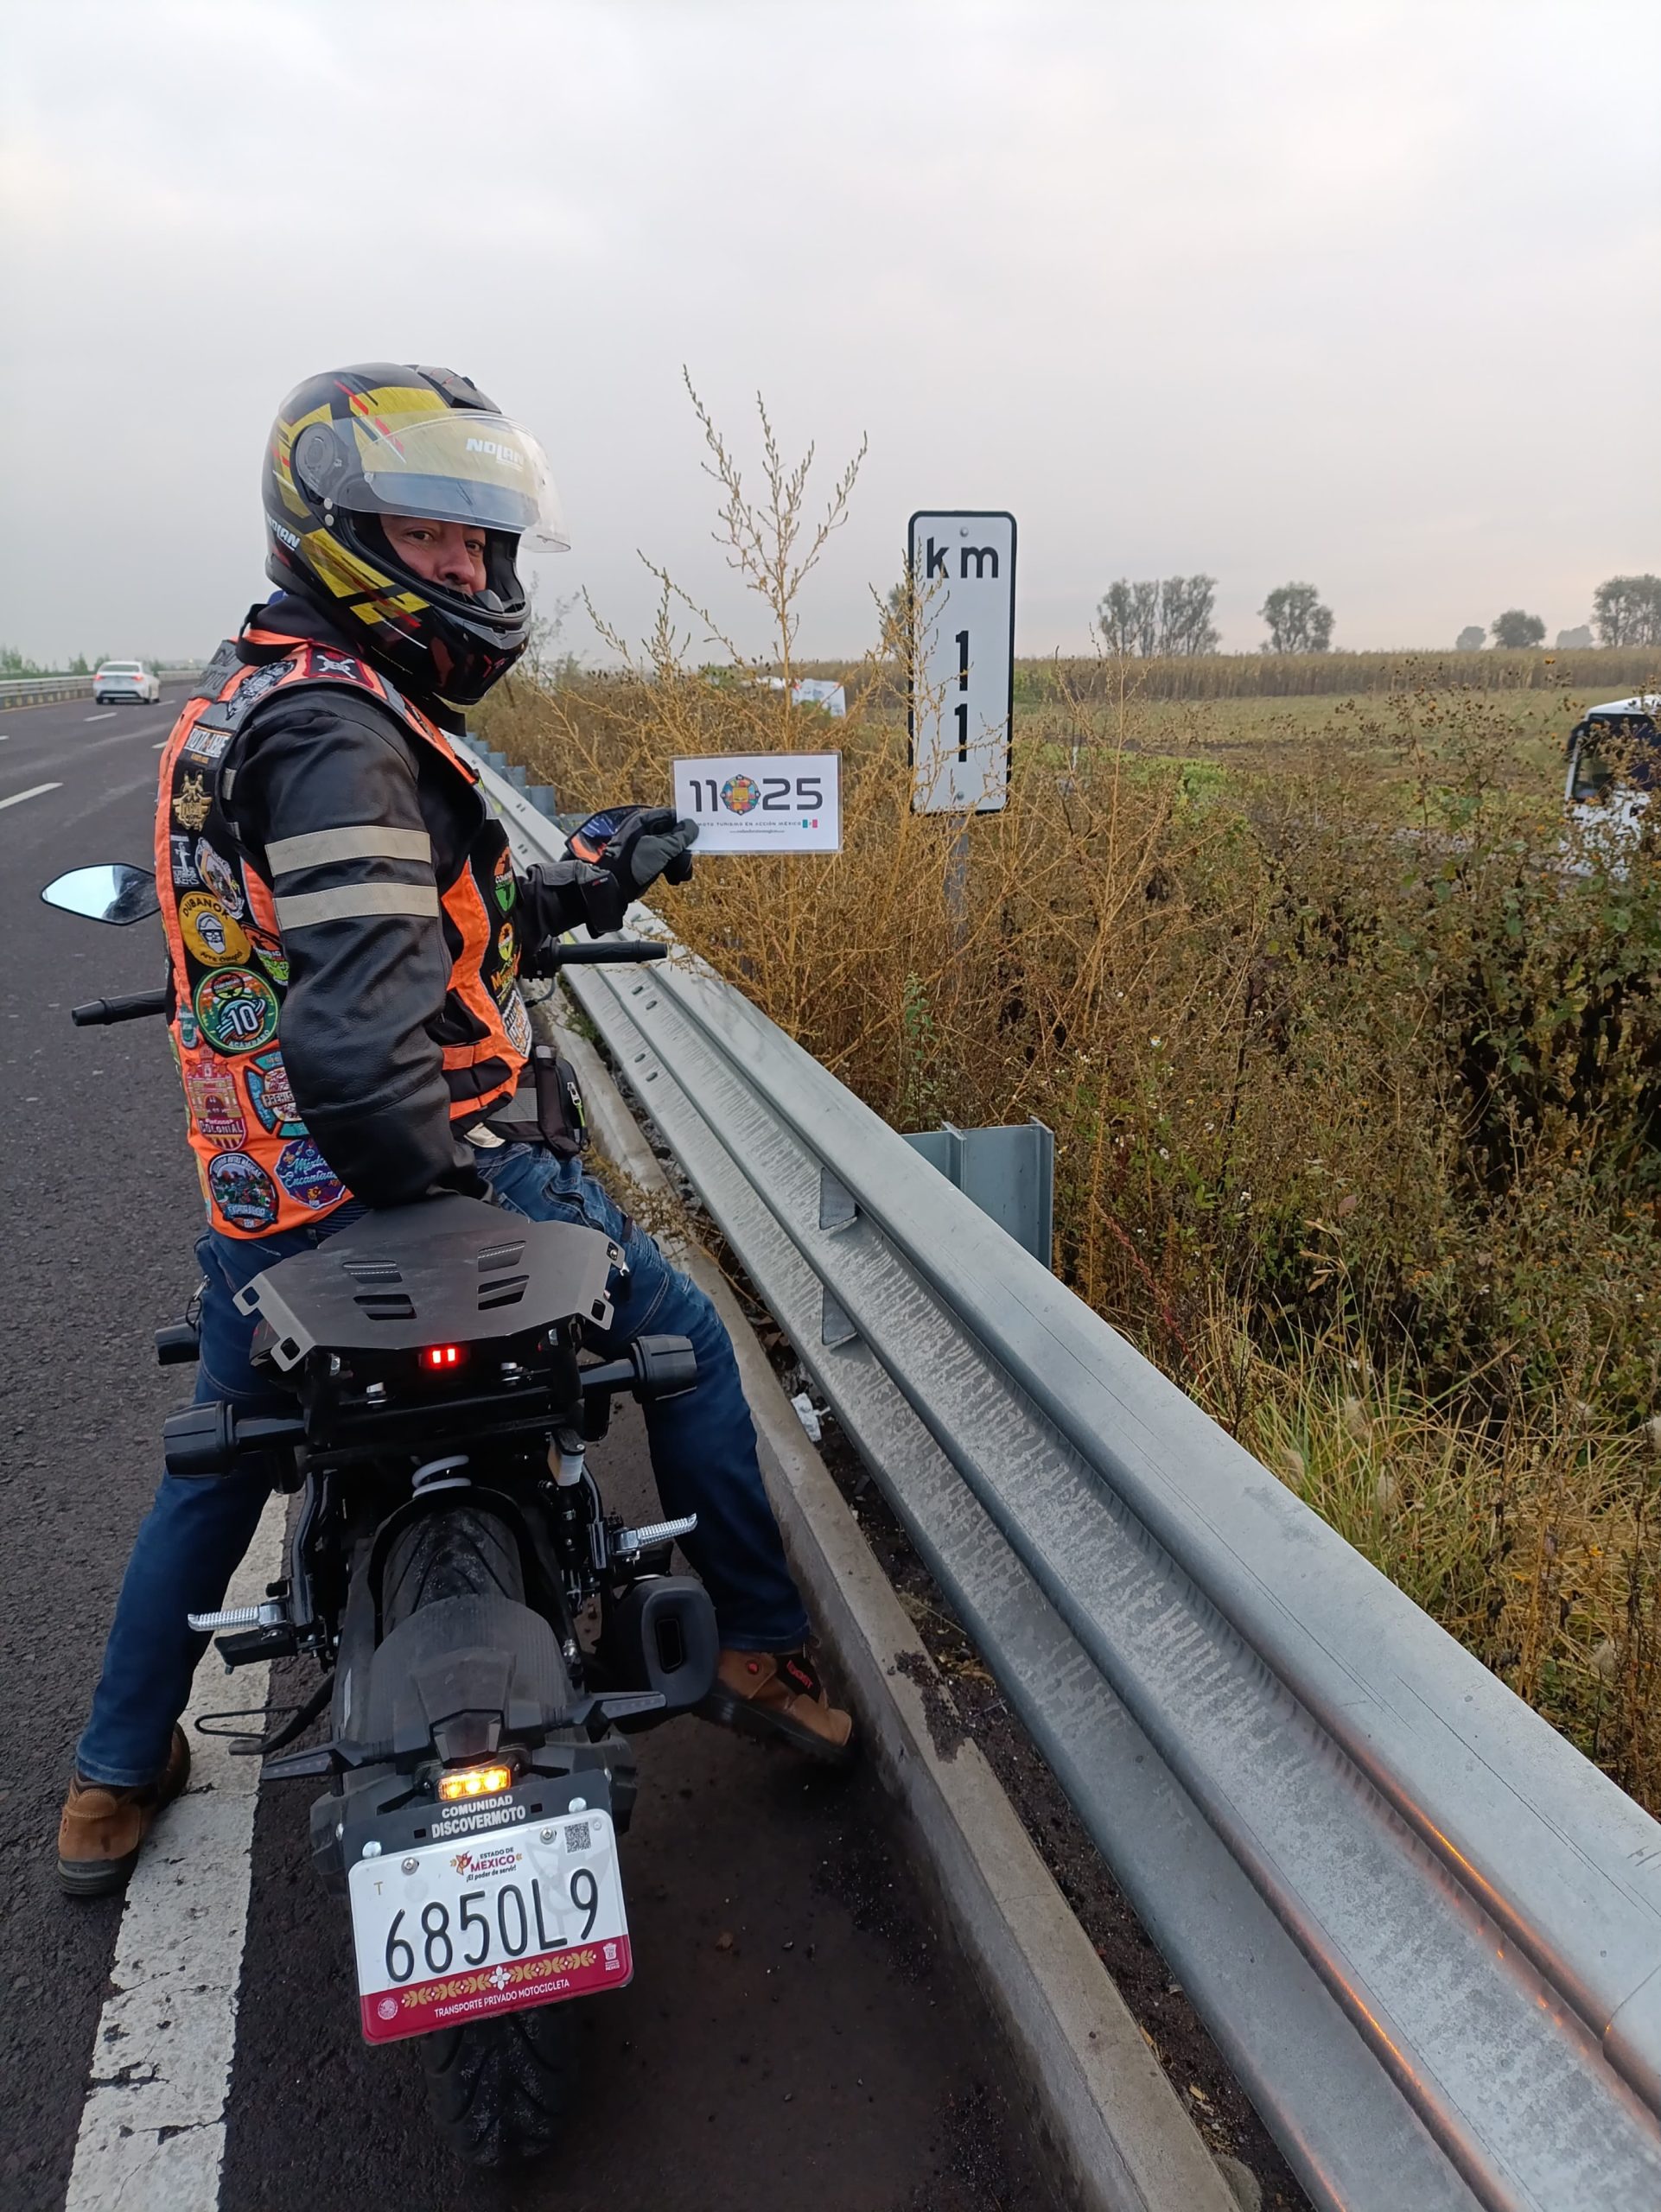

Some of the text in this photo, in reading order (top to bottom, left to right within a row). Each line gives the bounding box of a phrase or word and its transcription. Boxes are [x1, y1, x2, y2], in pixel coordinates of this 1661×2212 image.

[466, 437, 525, 469] NOLAN
[926, 537, 999, 579] km
[227, 1005, 258, 1036] 10
[199, 1120, 243, 1134] COLONIAL
[431, 1805, 526, 1839] DISCOVERMOTO
[442, 1795, 513, 1818] COMUNIDAD
[480, 1848, 505, 1859] ESTADO
[373, 1881, 384, 1895] T
[474, 1871, 491, 1881] poder
[499, 1864, 517, 1874] servir!
[385, 1868, 598, 1982] 6850L9
[435, 1979, 570, 2018] TRANSPORTE PRIVADO MOTOCICLETA
